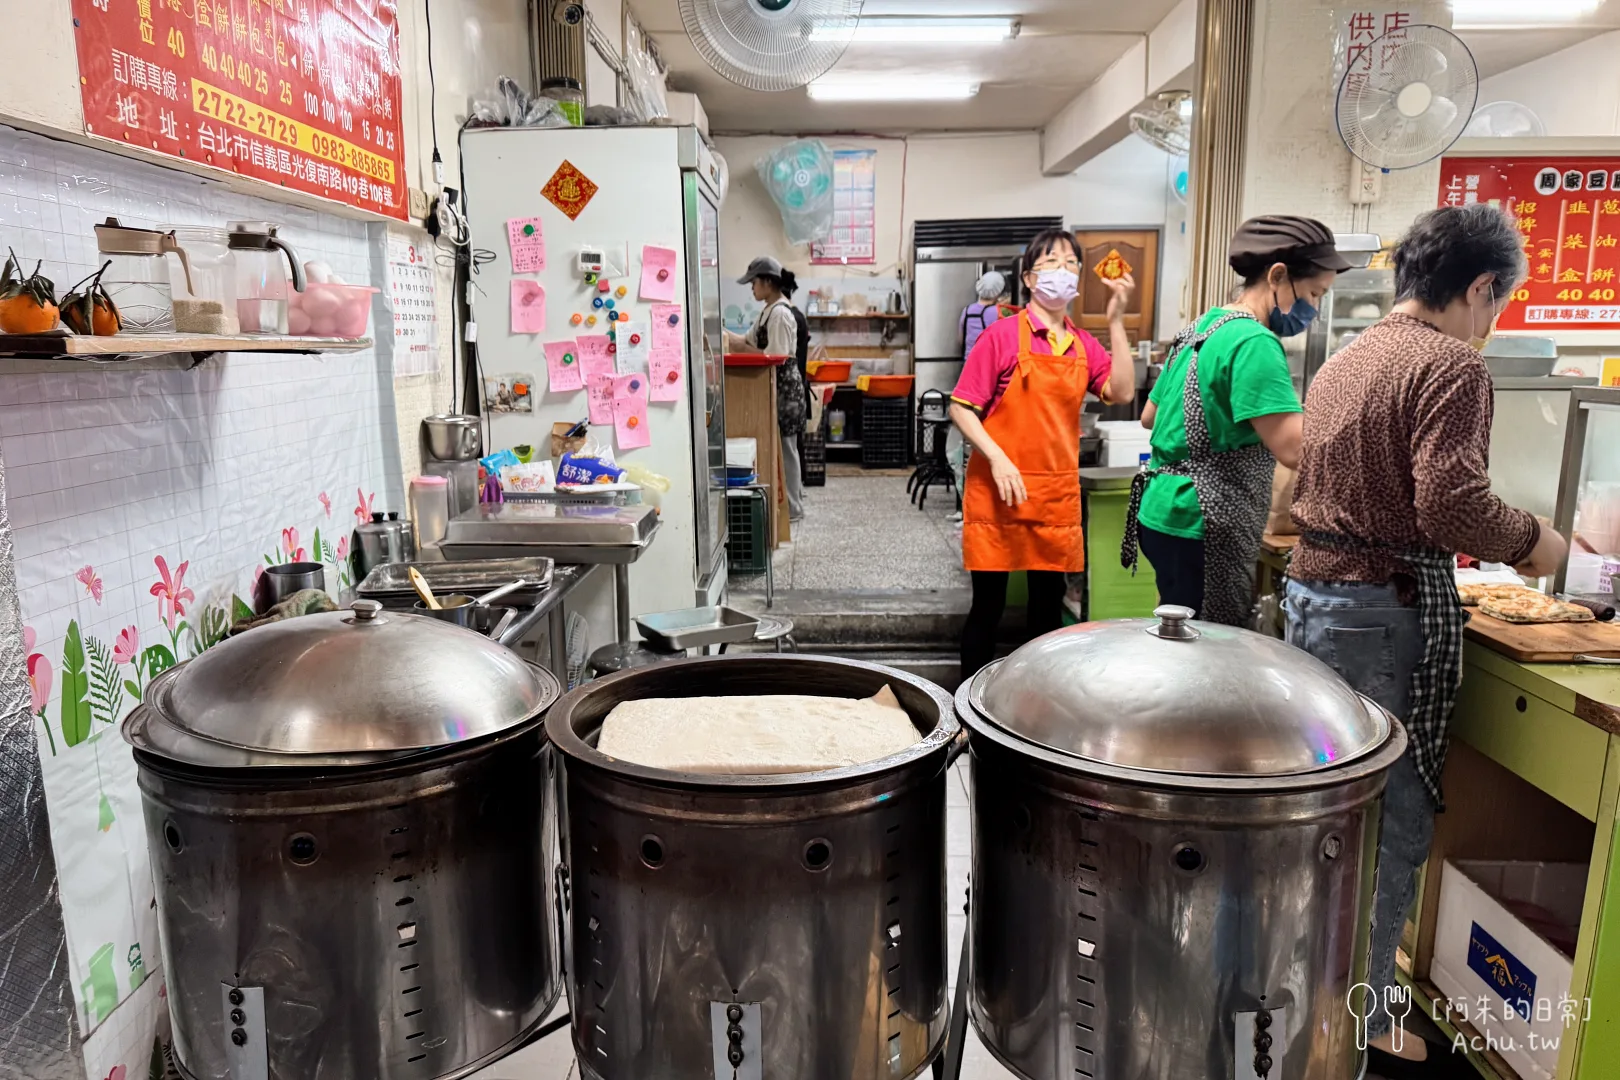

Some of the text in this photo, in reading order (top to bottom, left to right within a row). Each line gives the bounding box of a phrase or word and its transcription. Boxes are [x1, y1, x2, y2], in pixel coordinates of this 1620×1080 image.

[167, 26, 185, 58] 40
[202, 42, 217, 73] 40
[220, 51, 235, 81] 40
[238, 61, 252, 89] 40
[254, 67, 269, 96] 25
[279, 79, 293, 106] 25
[303, 90, 319, 117] 100
[322, 98, 335, 125] 100
[340, 105, 353, 132] 100
[197, 87, 391, 181] 2722-2729 0983-885865
[362, 119, 370, 140] 15
[376, 126, 385, 147] 20
[386, 130, 395, 151] 25
[198, 121, 394, 208] 台北市信義區光復南路419巷106號
[408, 246, 415, 263] 3
[1556, 288, 1583, 301] 40
[1588, 288, 1615, 301] 40
[562, 464, 593, 484] 舒潔
